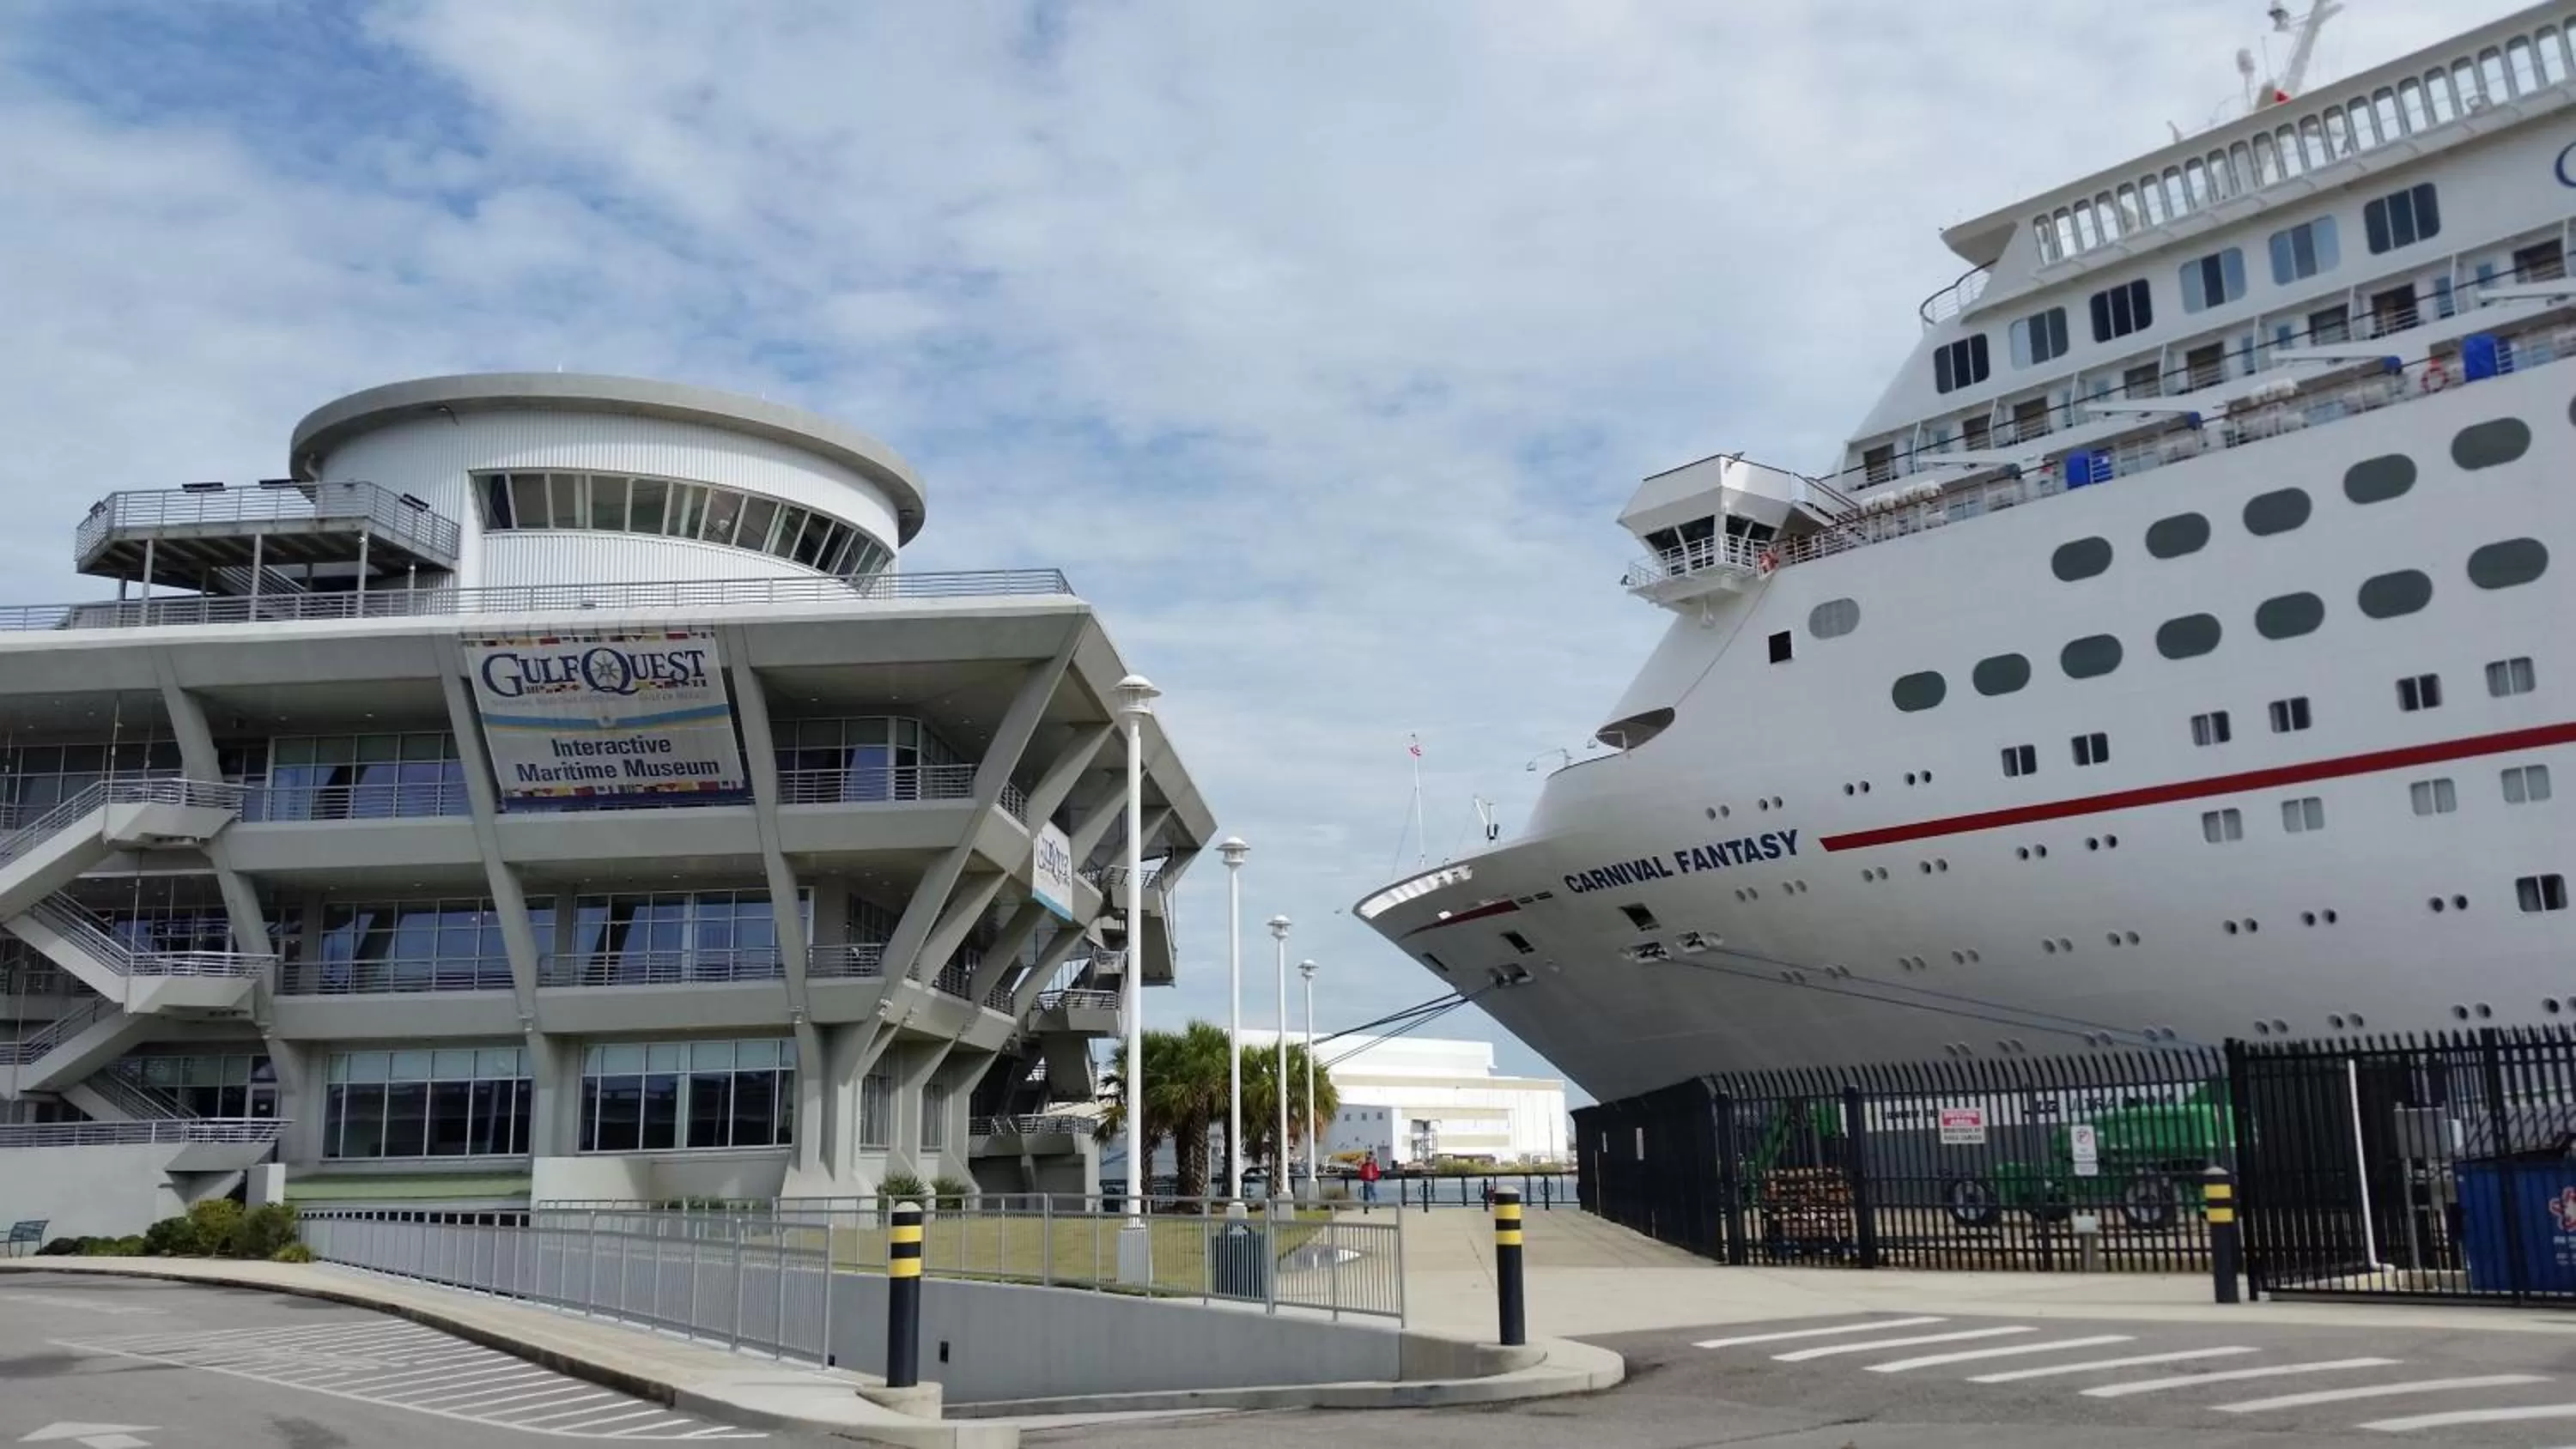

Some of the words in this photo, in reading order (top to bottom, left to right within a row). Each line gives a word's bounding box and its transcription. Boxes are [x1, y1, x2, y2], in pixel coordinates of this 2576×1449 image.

[482, 647, 706, 697] GULFQUEST
[552, 736, 672, 757] Interactive
[516, 761, 618, 783] Maritime
[623, 759, 720, 779] Museum
[1564, 856, 1674, 894] CARNIVAL
[1674, 829, 1798, 874] FANTASY
